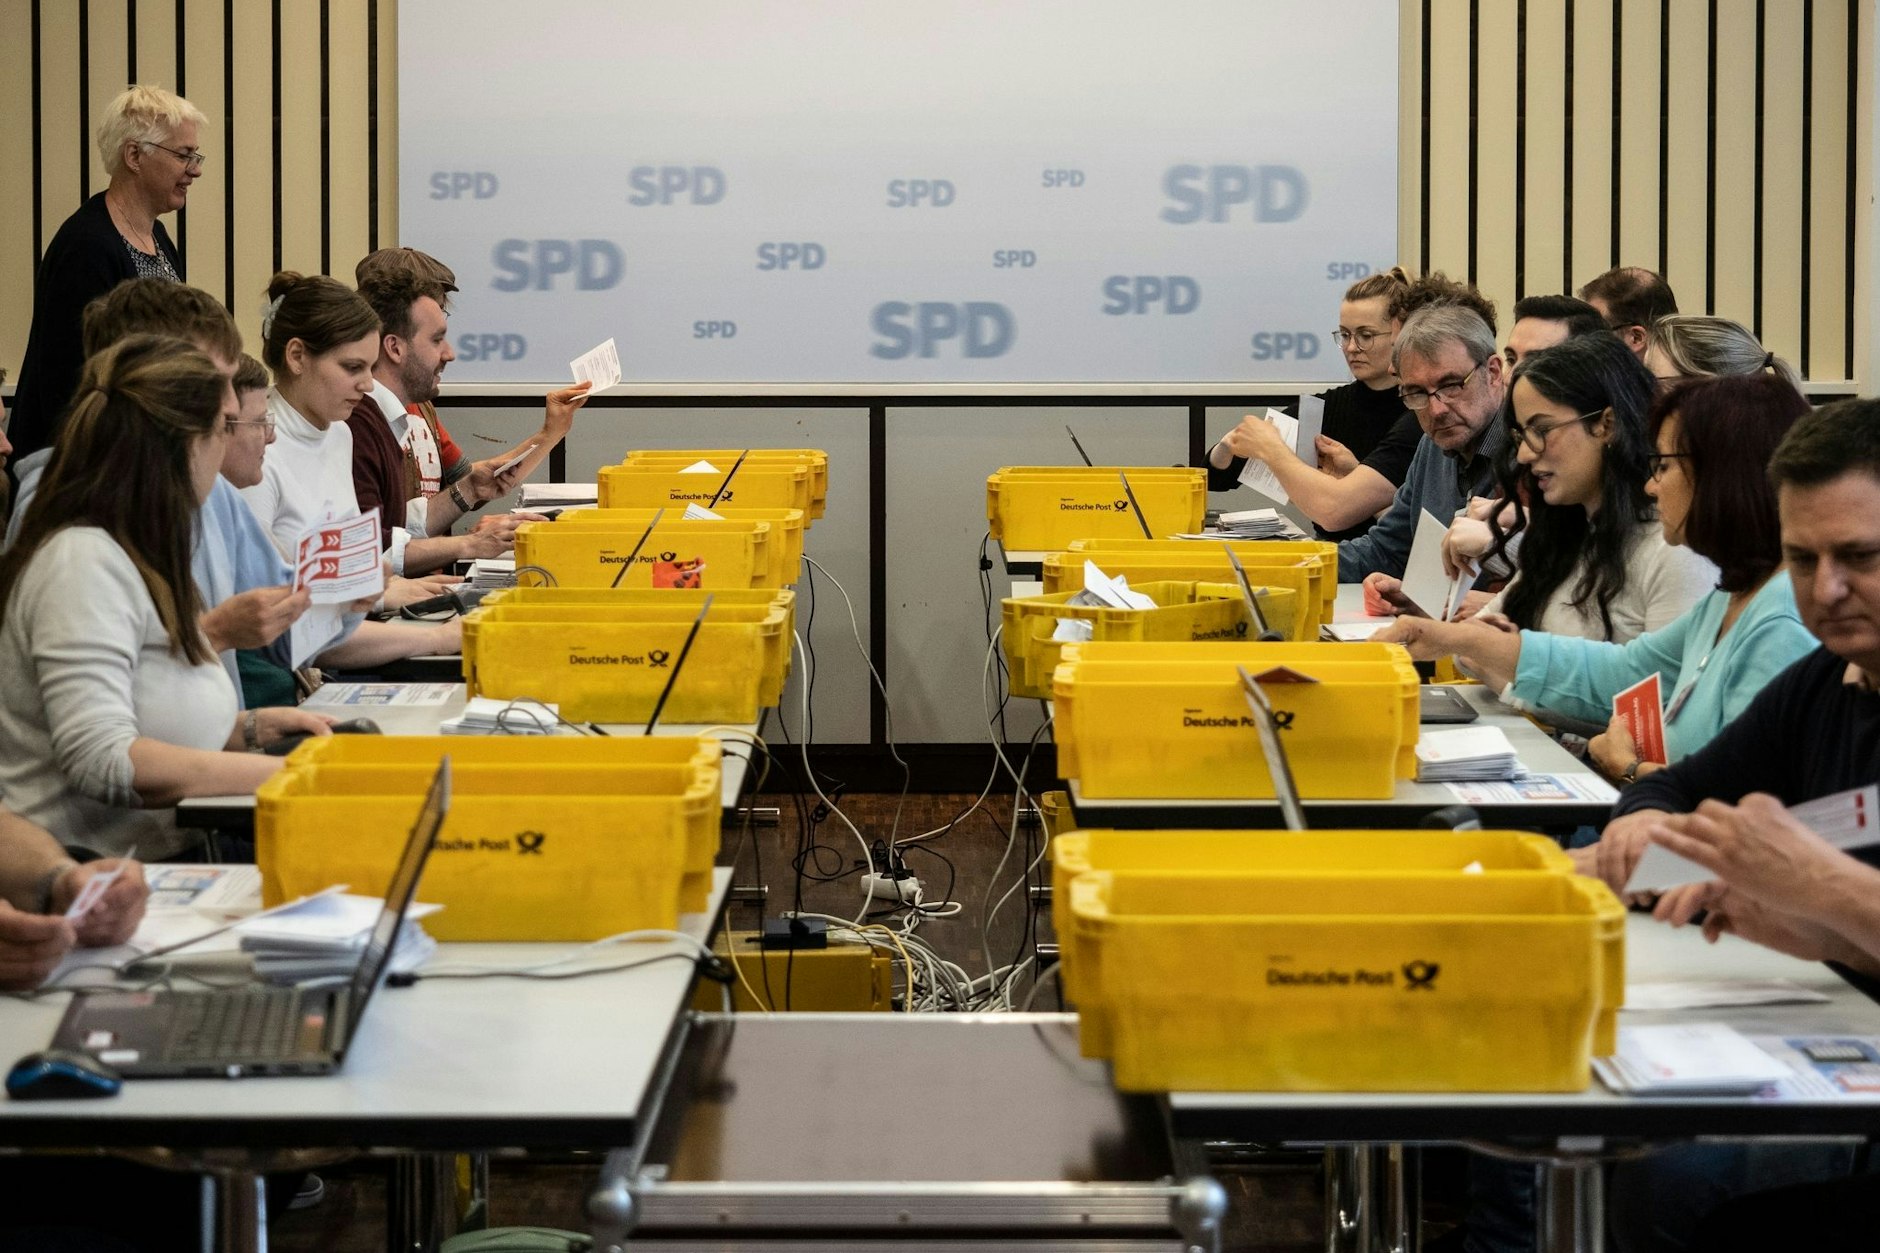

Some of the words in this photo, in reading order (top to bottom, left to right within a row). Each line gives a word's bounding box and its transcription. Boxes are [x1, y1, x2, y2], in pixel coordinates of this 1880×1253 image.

[429, 171, 498, 200] SPD
[627, 165, 728, 207] SPD
[1042, 168, 1085, 188] SPD
[886, 179, 957, 208] SPD
[1159, 163, 1309, 225] SPD
[491, 238, 627, 293] SPD
[756, 242, 826, 271] SPD
[992, 249, 1037, 268] SPD
[1327, 262, 1370, 280] SPD
[1101, 275, 1201, 315] SPD
[692, 320, 737, 339] SPD
[868, 300, 1016, 361] SPD
[458, 333, 528, 362] SPD
[1250, 332, 1321, 361] SPD
[1060, 503, 1095, 511] Deutsche
[1095, 503, 1112, 511] Post
[639, 555, 657, 565] Post
[569, 654, 619, 665] Deutsche
[621, 654, 645, 665] Post
[1183, 716, 1239, 727] Deutsche
[479, 838, 511, 850] Post
[1266, 968, 1351, 986] Deutsche
[1354, 969, 1394, 986] Post
